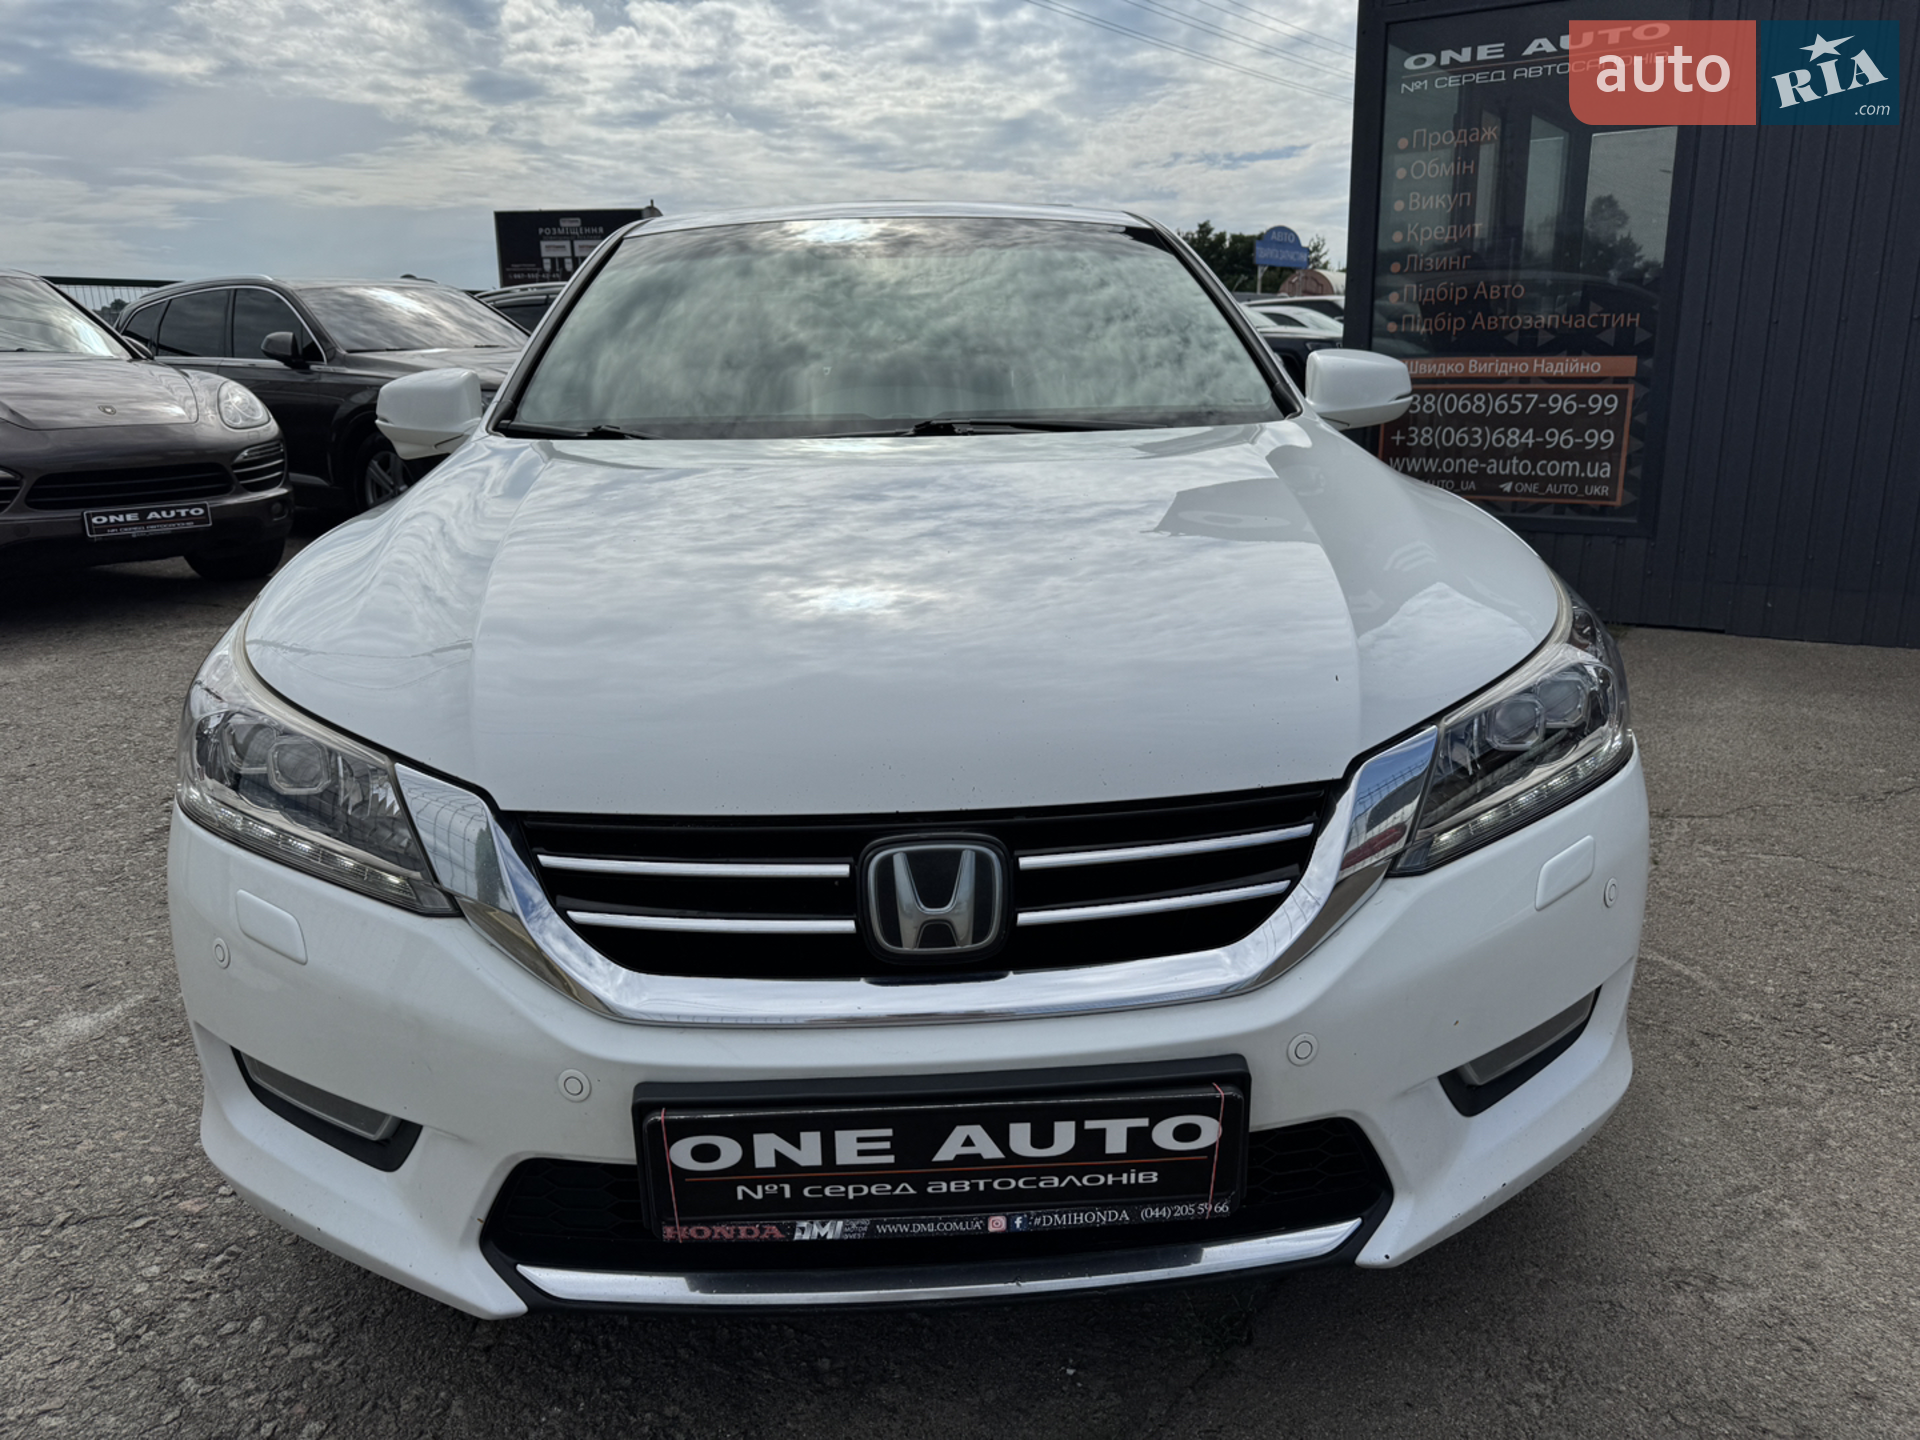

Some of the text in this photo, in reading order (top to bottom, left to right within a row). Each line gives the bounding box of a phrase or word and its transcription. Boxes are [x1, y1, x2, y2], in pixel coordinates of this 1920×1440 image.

[1403, 22, 1671, 70] ONE AUTO
[1401, 79, 1428, 94] №1
[1434, 69, 1506, 89] СЕРЕД
[1412, 126, 1498, 151] Продаж
[1410, 157, 1475, 180] Обмін
[1408, 192, 1472, 213] Викуп
[1407, 222, 1483, 246] Кредит
[1403, 254, 1471, 272] Лізинг
[1403, 281, 1525, 305] Підбір Авто
[1401, 311, 1640, 335] Підбір Автозапчастин
[1405, 358, 1601, 376] Швидко Вигідно Надійно
[1408, 392, 1618, 416] 38(068)657-96-99
[1390, 425, 1615, 451] +38(063)684-96-99
[1389, 455, 1612, 478] www.one-auto.com.ua
[1514, 481, 1609, 497] ONE_AUTO_UKR
[92, 507, 205, 525] ONE AUTO
[669, 1114, 1223, 1171] ONE AUTO
[736, 1183, 791, 1200] №1
[1033, 1210, 1130, 1228] #DMIHONDA
[1140, 1206, 1172, 1221] (044)
[1173, 1203, 1196, 1217] 205
[1214, 1202, 1229, 1213] 66
[663, 1224, 786, 1241] HONDA
